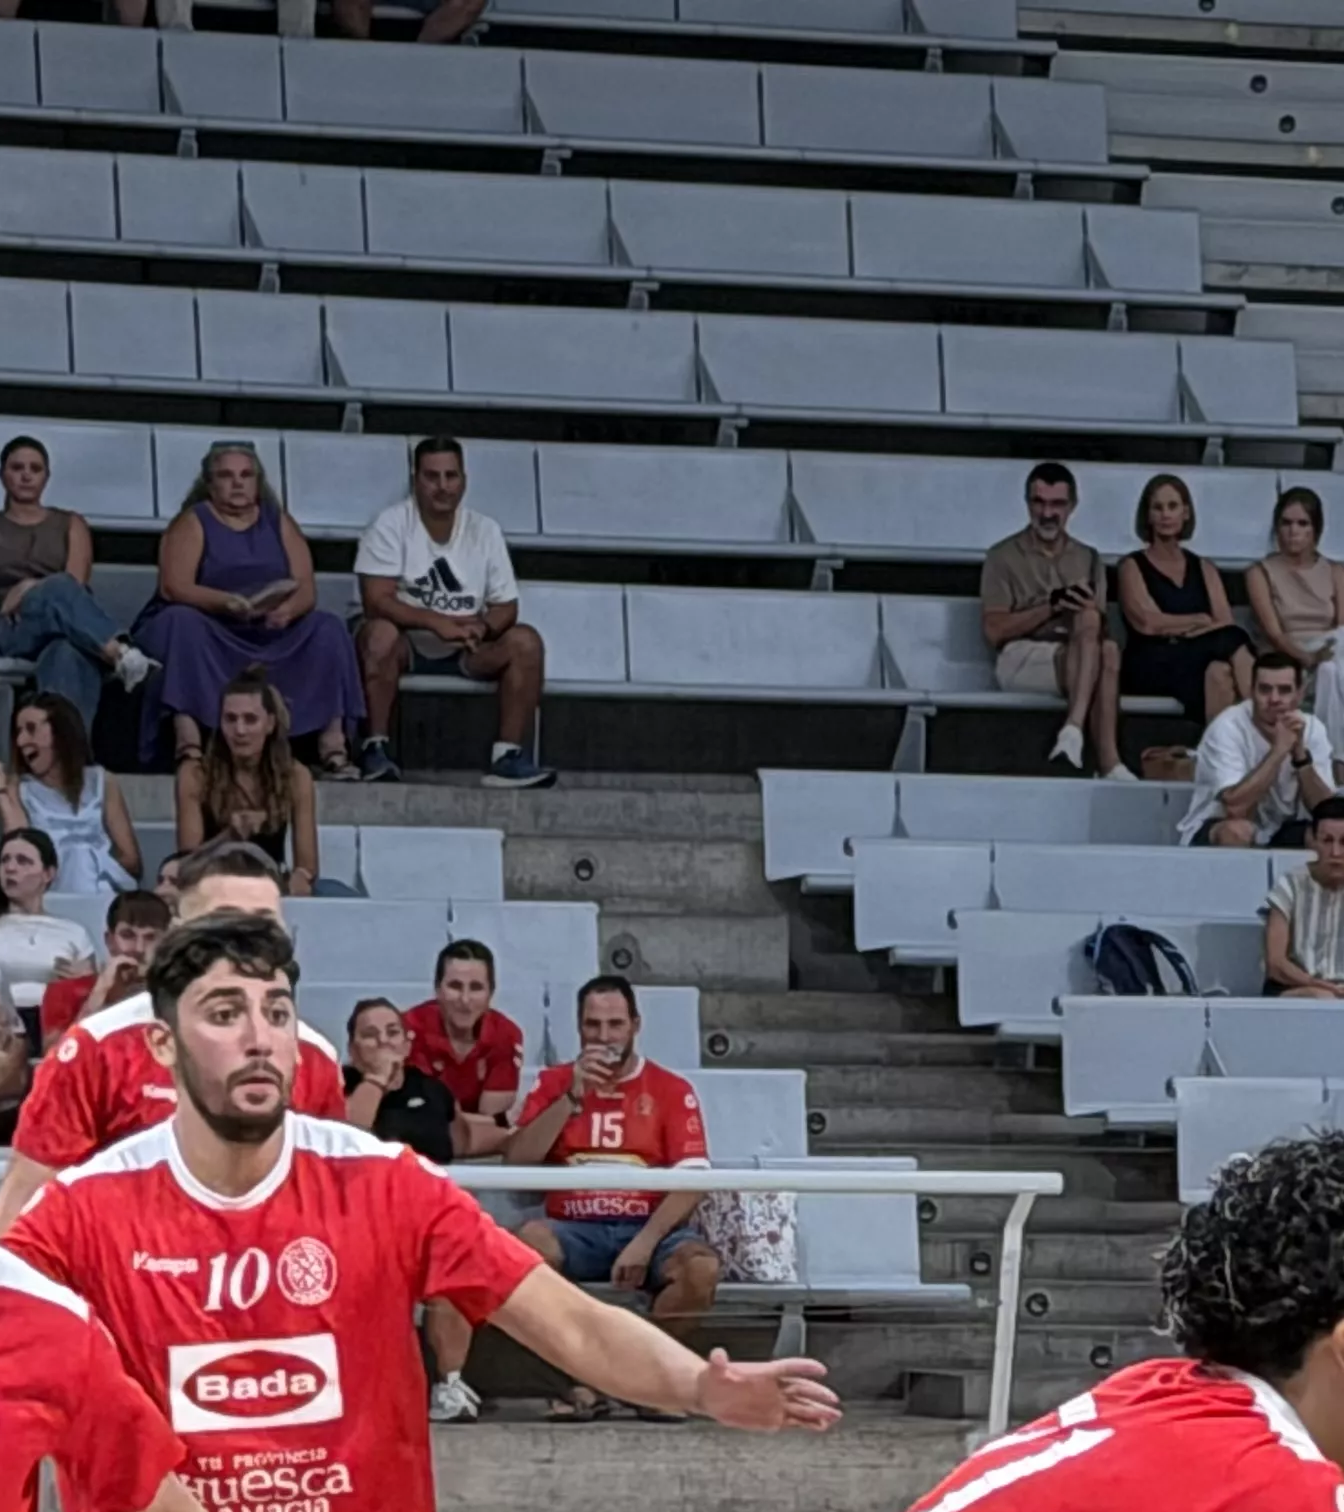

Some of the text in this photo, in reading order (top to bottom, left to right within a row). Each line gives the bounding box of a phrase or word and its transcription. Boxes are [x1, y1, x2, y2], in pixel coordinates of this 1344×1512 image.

[591, 1111, 625, 1148] 15
[203, 1247, 270, 1311] 10
[196, 1369, 317, 1401] Bada
